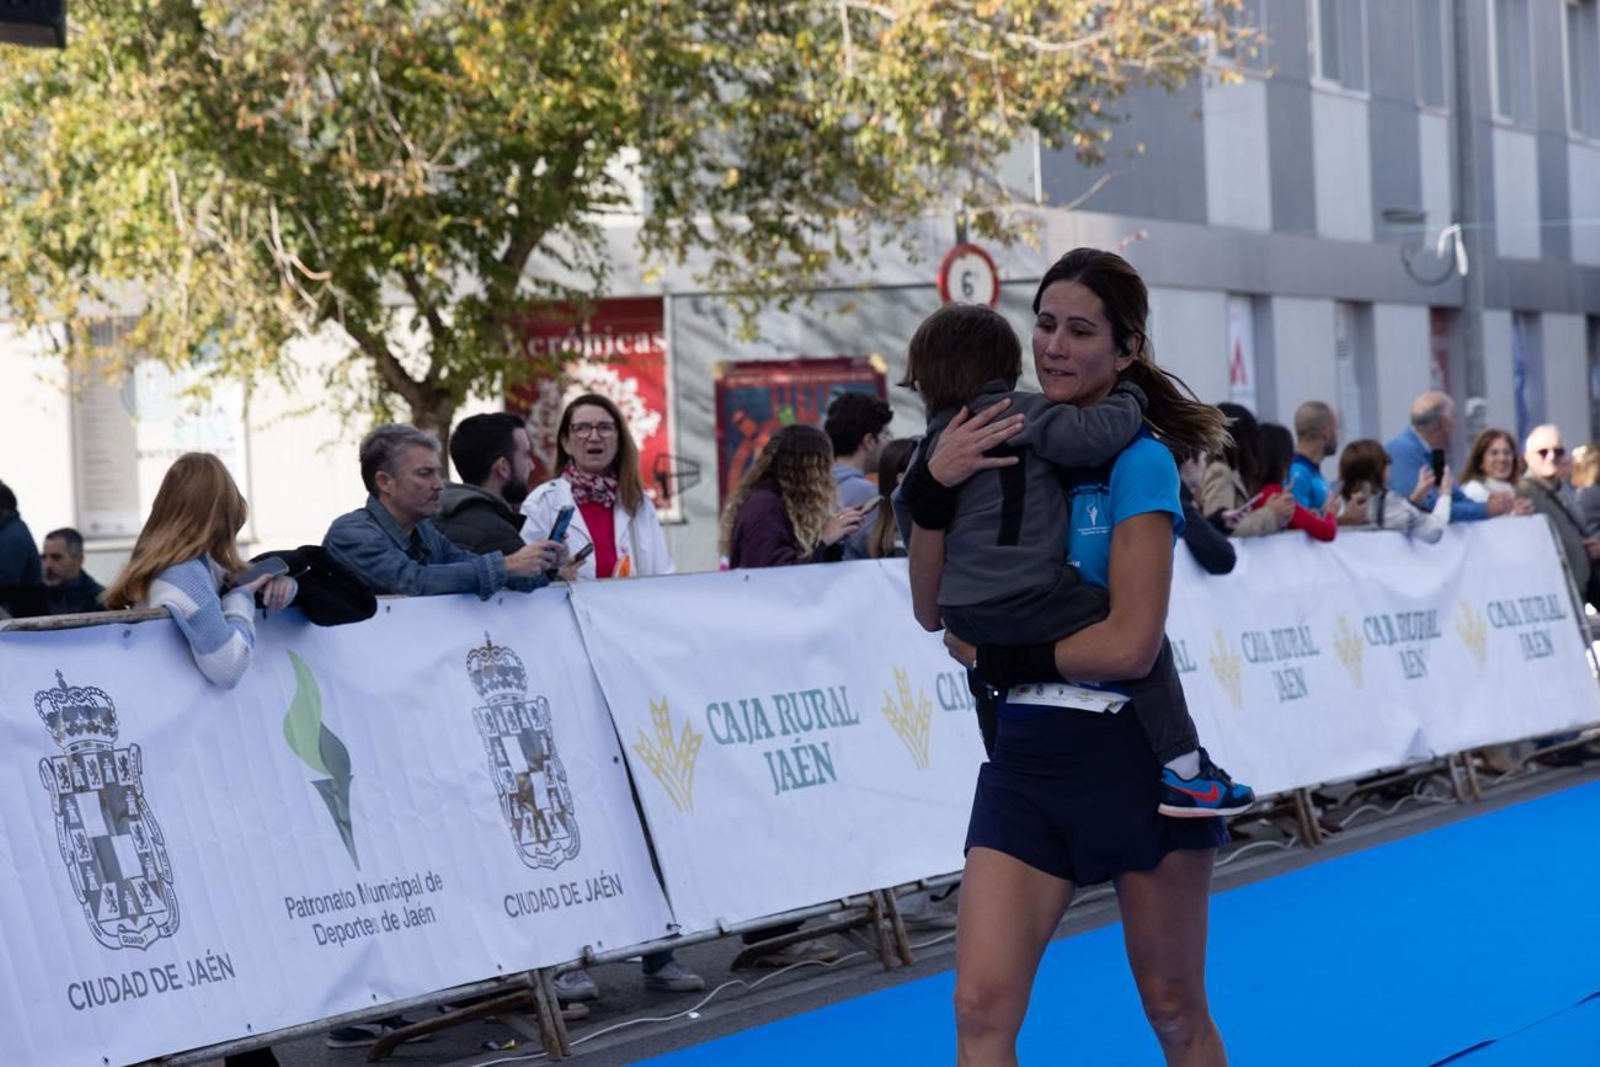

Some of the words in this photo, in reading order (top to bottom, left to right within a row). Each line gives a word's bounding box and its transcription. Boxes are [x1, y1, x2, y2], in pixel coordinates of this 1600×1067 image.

[705, 698, 775, 745] CAJA
[772, 685, 860, 736] RURAL
[936, 671, 976, 711] CAJ
[764, 738, 837, 795] JAÉN
[284, 887, 357, 920] Patronato
[356, 872, 424, 905] Municipal
[425, 869, 444, 893] de
[503, 887, 560, 918] CIUDAD
[560, 881, 583, 907] DE
[586, 869, 624, 902] JAÉN
[312, 916, 381, 947] Deportes
[381, 909, 400, 932] de
[402, 901, 436, 928] Jaén
[67, 970, 149, 1011] CIUDAD
[149, 963, 184, 994] DE
[186, 948, 236, 987] JAÉN
